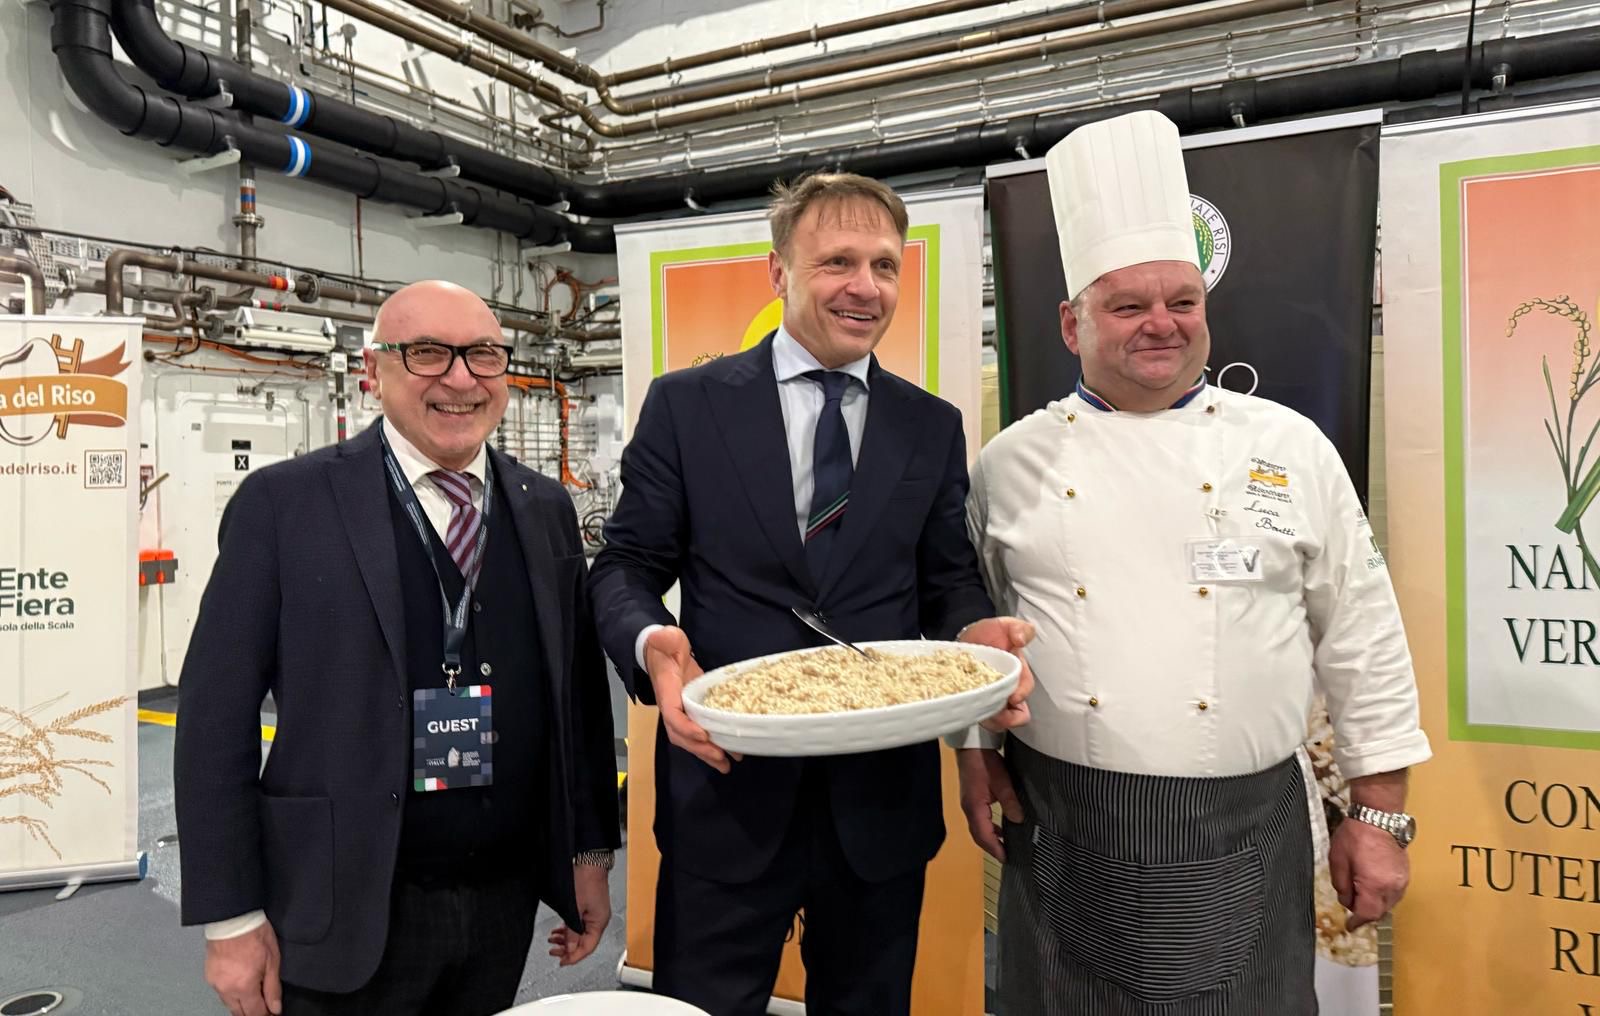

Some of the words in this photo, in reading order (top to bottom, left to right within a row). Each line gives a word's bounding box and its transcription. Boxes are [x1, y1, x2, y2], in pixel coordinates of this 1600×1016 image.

[1213, 227, 1226, 255] RISI
[13, 384, 44, 408] del
[51, 384, 96, 405] Riso
[237, 456, 247, 469] X
[1243, 500, 1280, 517] Luca
[0, 568, 69, 590] Ente
[0, 591, 75, 616] Fiera
[20, 621, 45, 631] della
[48, 619, 75, 630] Scala
[1503, 618, 1600, 665] VER
[427, 718, 479, 733] GUEST
